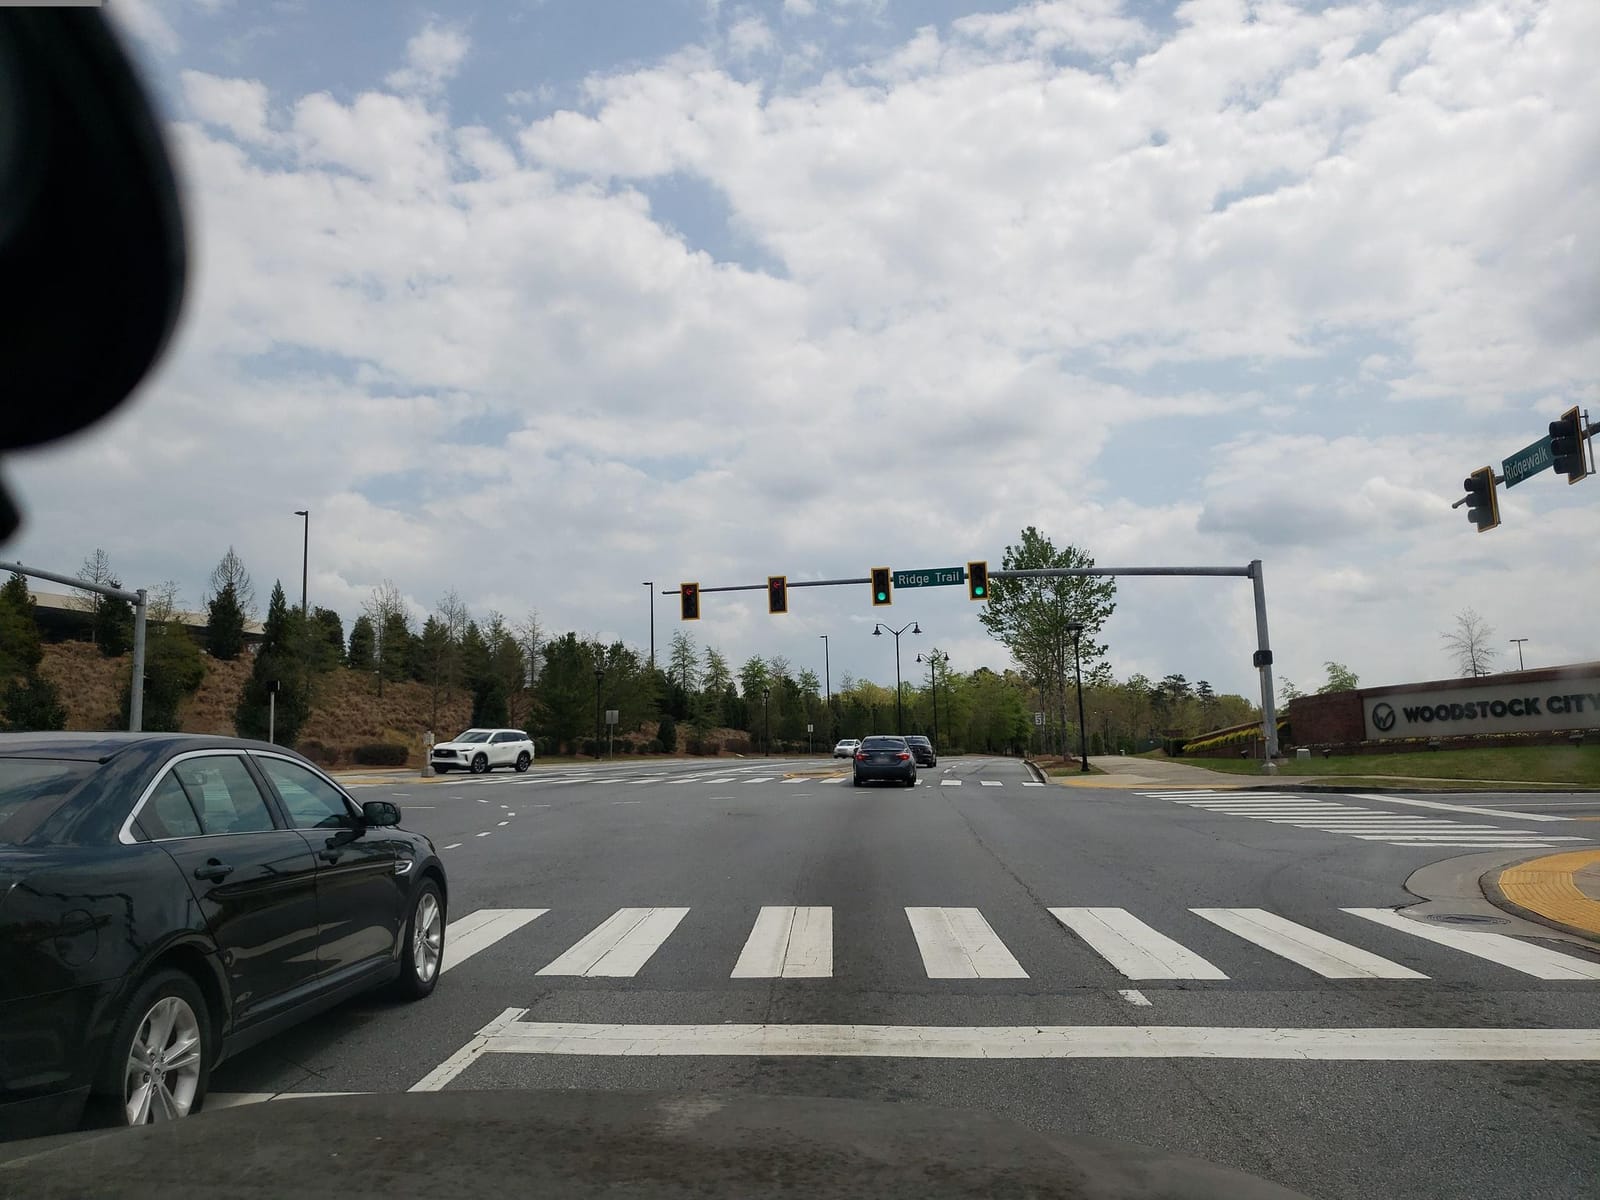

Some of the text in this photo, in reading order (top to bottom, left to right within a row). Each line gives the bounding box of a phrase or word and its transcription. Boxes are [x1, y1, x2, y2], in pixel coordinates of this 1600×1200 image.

[1505, 446, 1549, 480] Ridgewalk
[898, 571, 959, 586] Ridge Trail
[1403, 697, 1542, 723] WOODSTOCK
